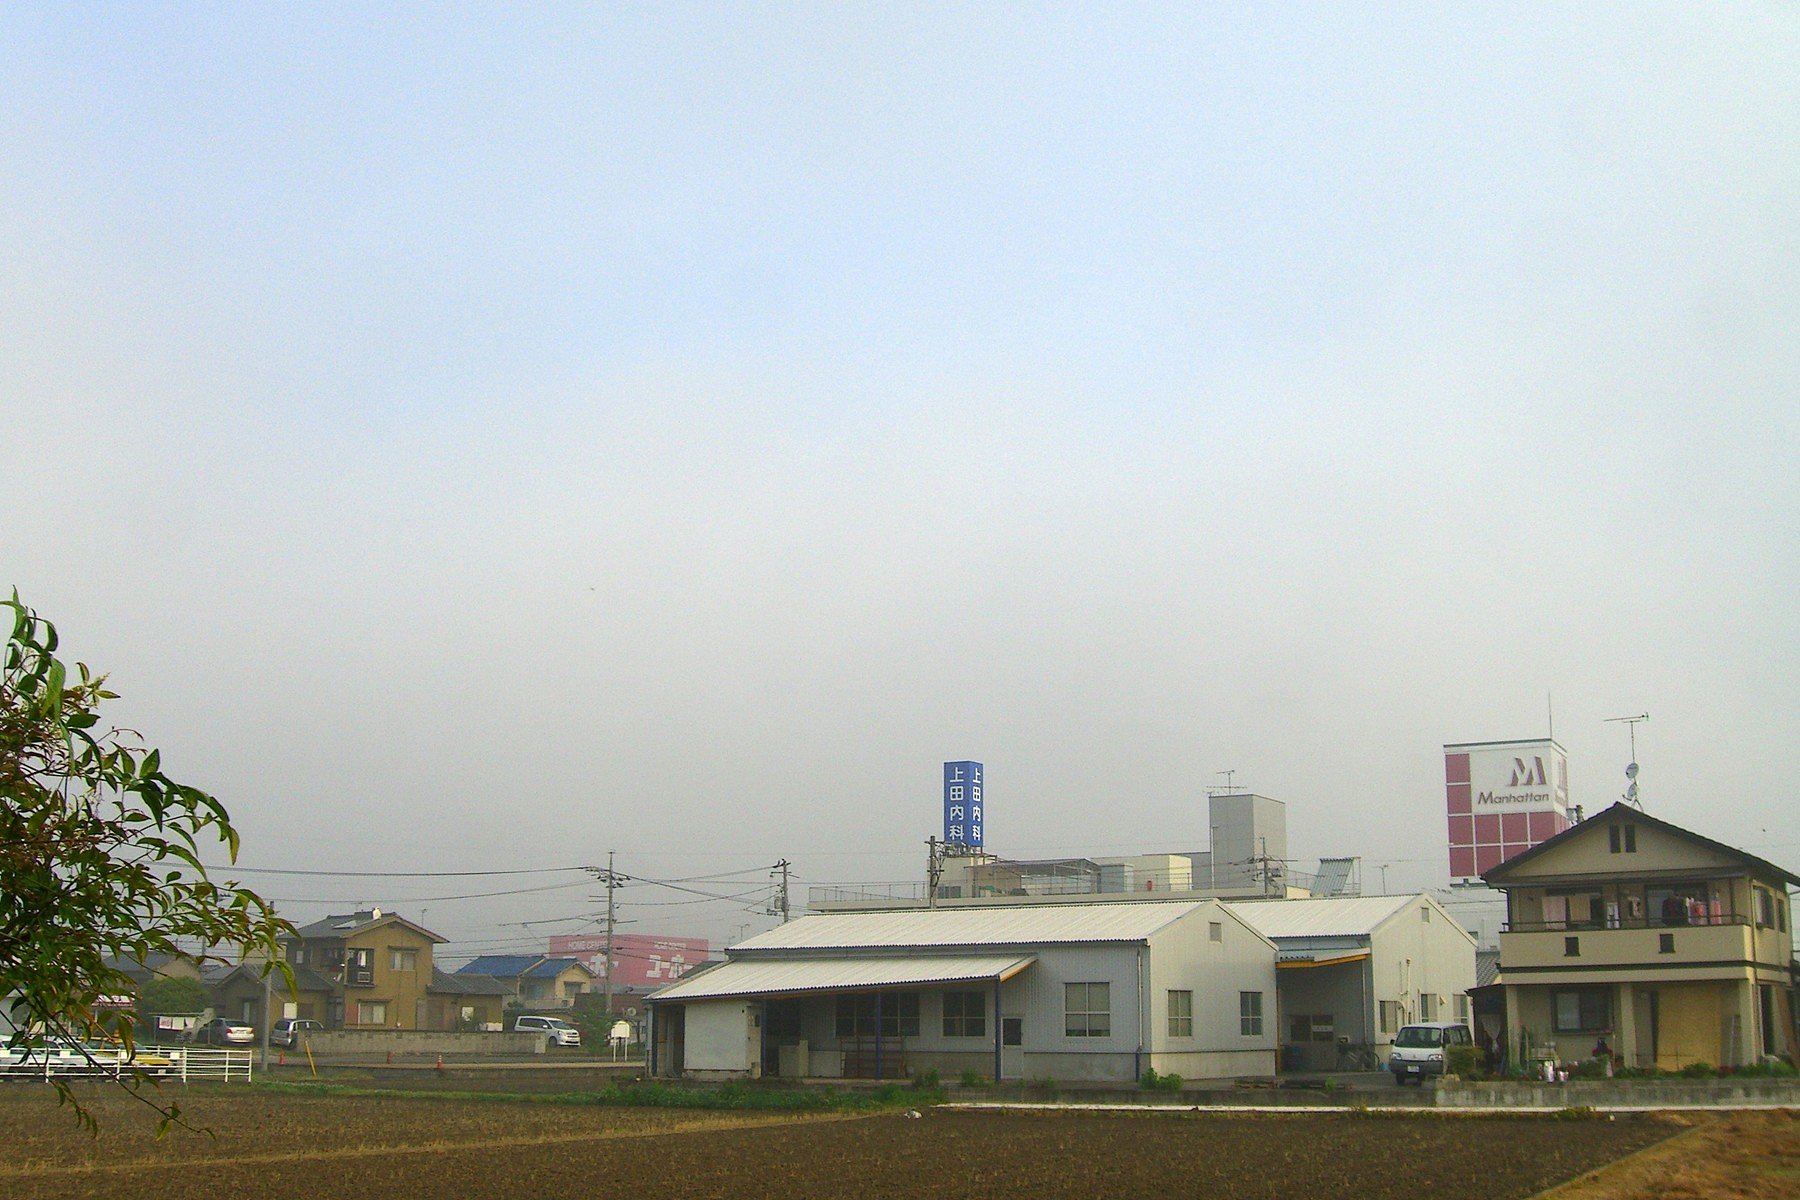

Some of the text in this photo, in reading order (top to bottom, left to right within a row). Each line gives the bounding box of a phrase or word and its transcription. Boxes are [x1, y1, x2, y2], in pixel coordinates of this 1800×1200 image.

[949, 766, 965, 841] 上田内科
[972, 767, 982, 842] 上田内科
[1478, 791, 1550, 805] Manhattan
